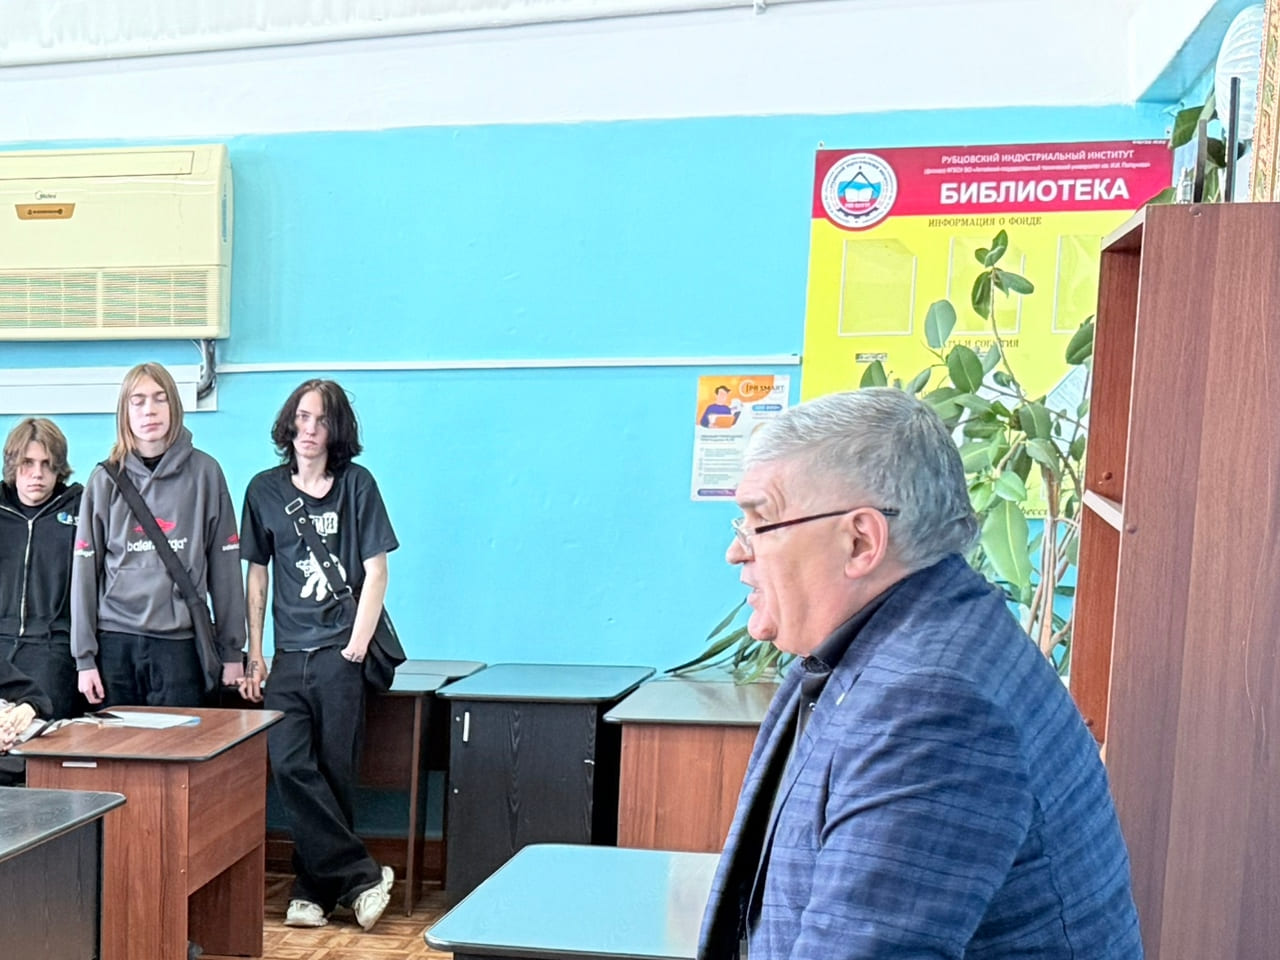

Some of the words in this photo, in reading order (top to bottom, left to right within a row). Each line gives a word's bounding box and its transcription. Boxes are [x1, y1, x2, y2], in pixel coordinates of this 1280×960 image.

[941, 153, 999, 164] РУБЦОВСКИЙ
[1001, 150, 1085, 163] ИНДУСТРИАЛЬНЫЙ
[1087, 149, 1135, 160] ИНСТИТУТ
[940, 177, 1130, 205] БИБЛИОТЕКА
[928, 217, 995, 228] ИНФОРМАЦИЯ
[1008, 216, 1042, 226] ФОНДЕ
